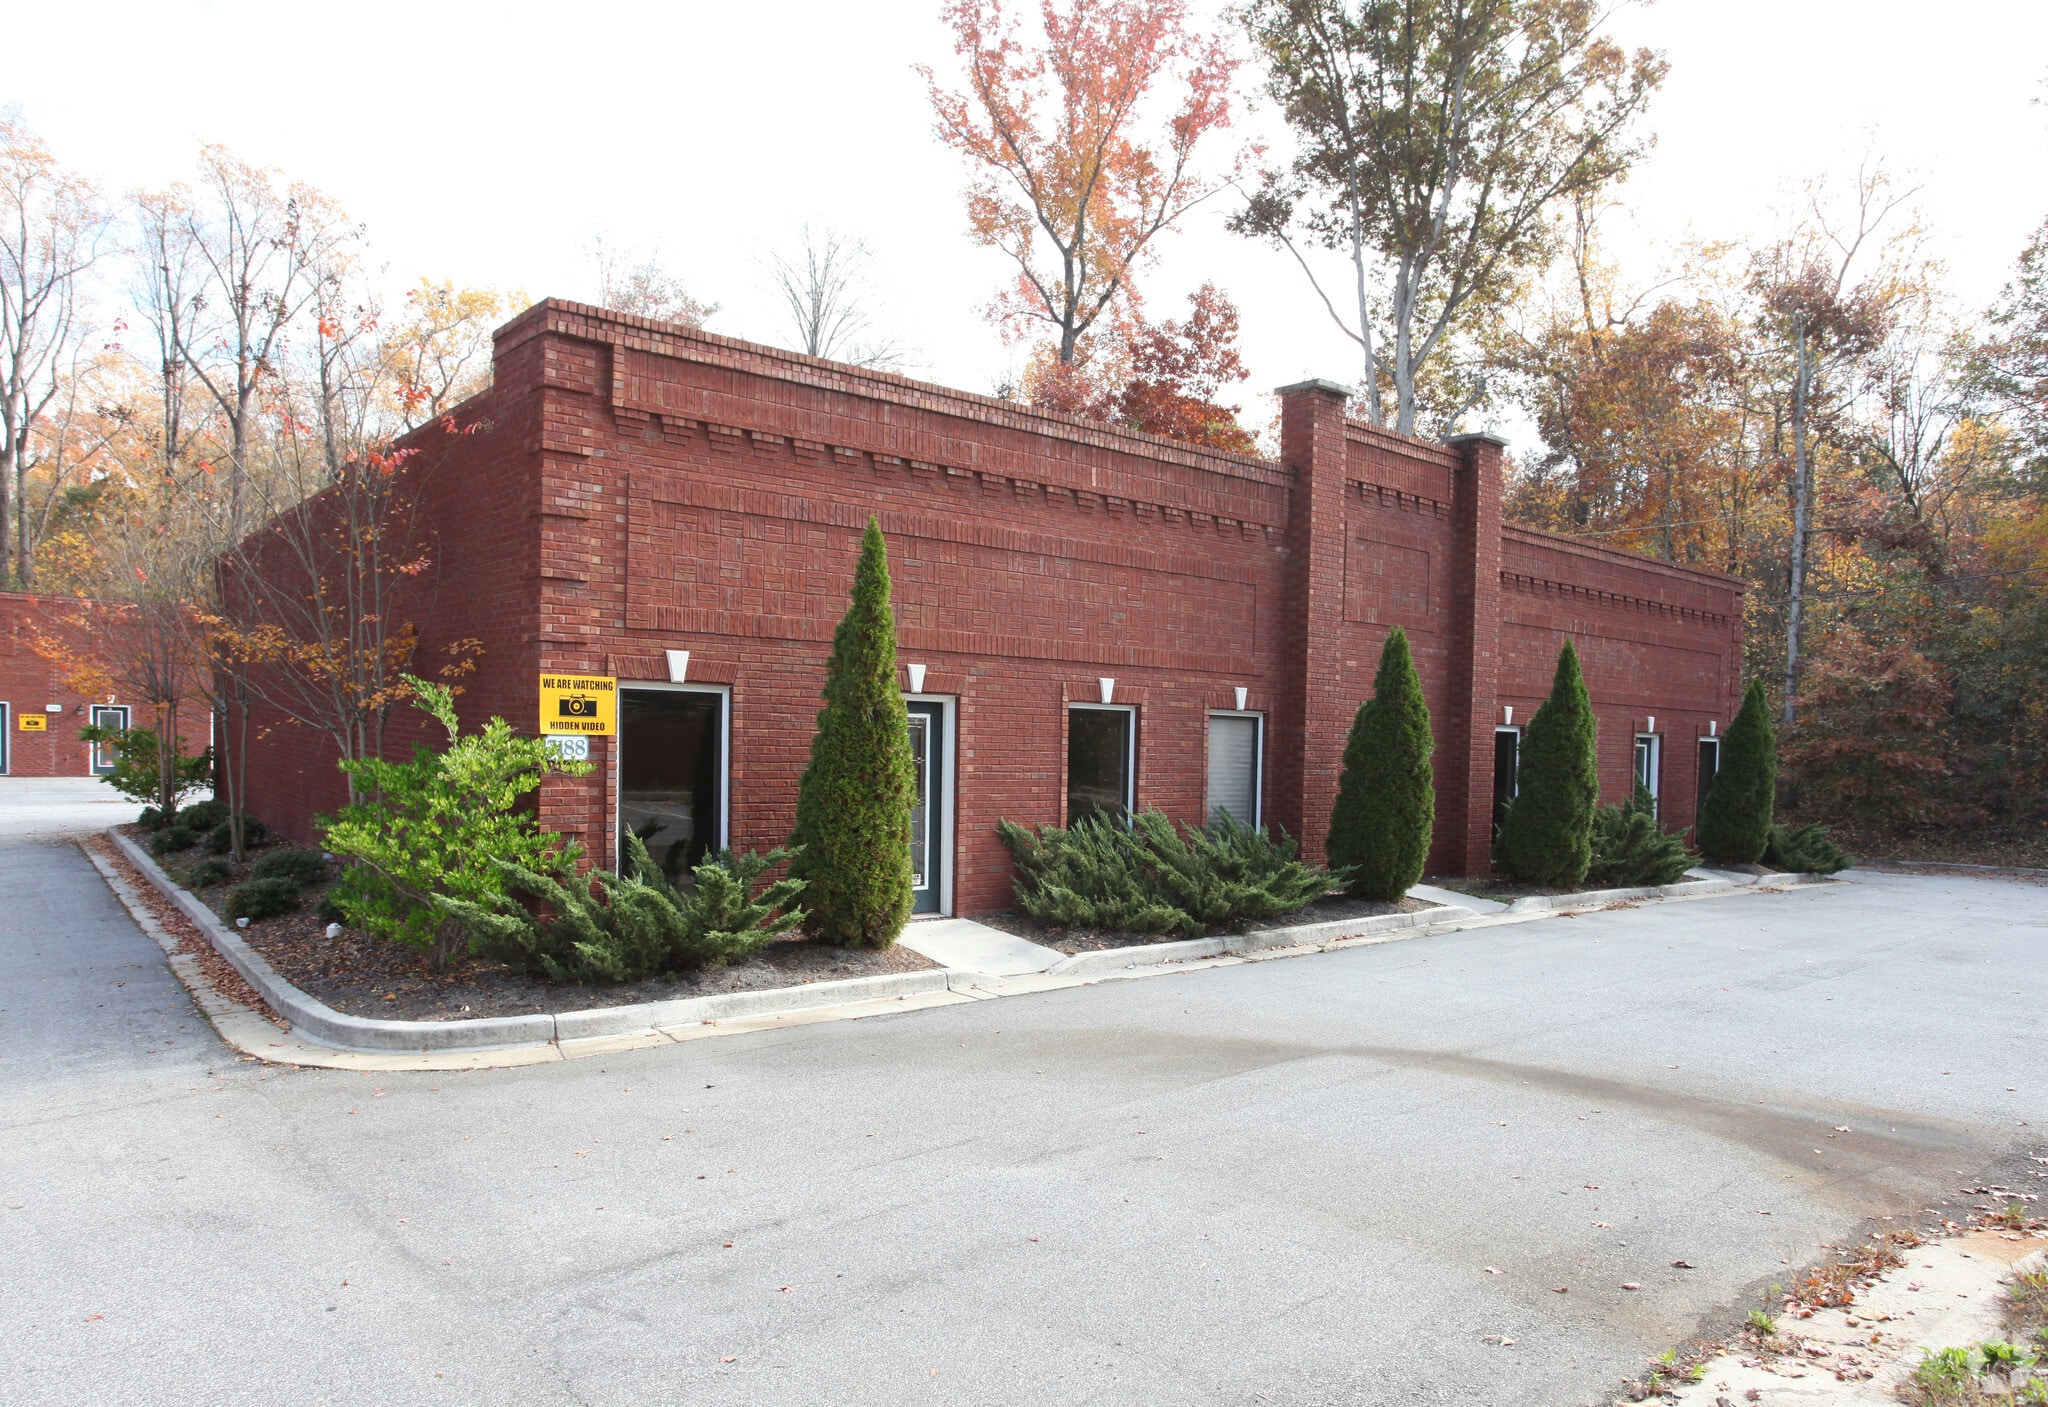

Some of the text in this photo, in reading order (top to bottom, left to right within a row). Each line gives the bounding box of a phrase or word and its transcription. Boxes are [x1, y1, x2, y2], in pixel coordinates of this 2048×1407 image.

[543, 678, 613, 691] WE ARE WATCHING
[550, 721, 605, 731] HIDDEN VIDEO
